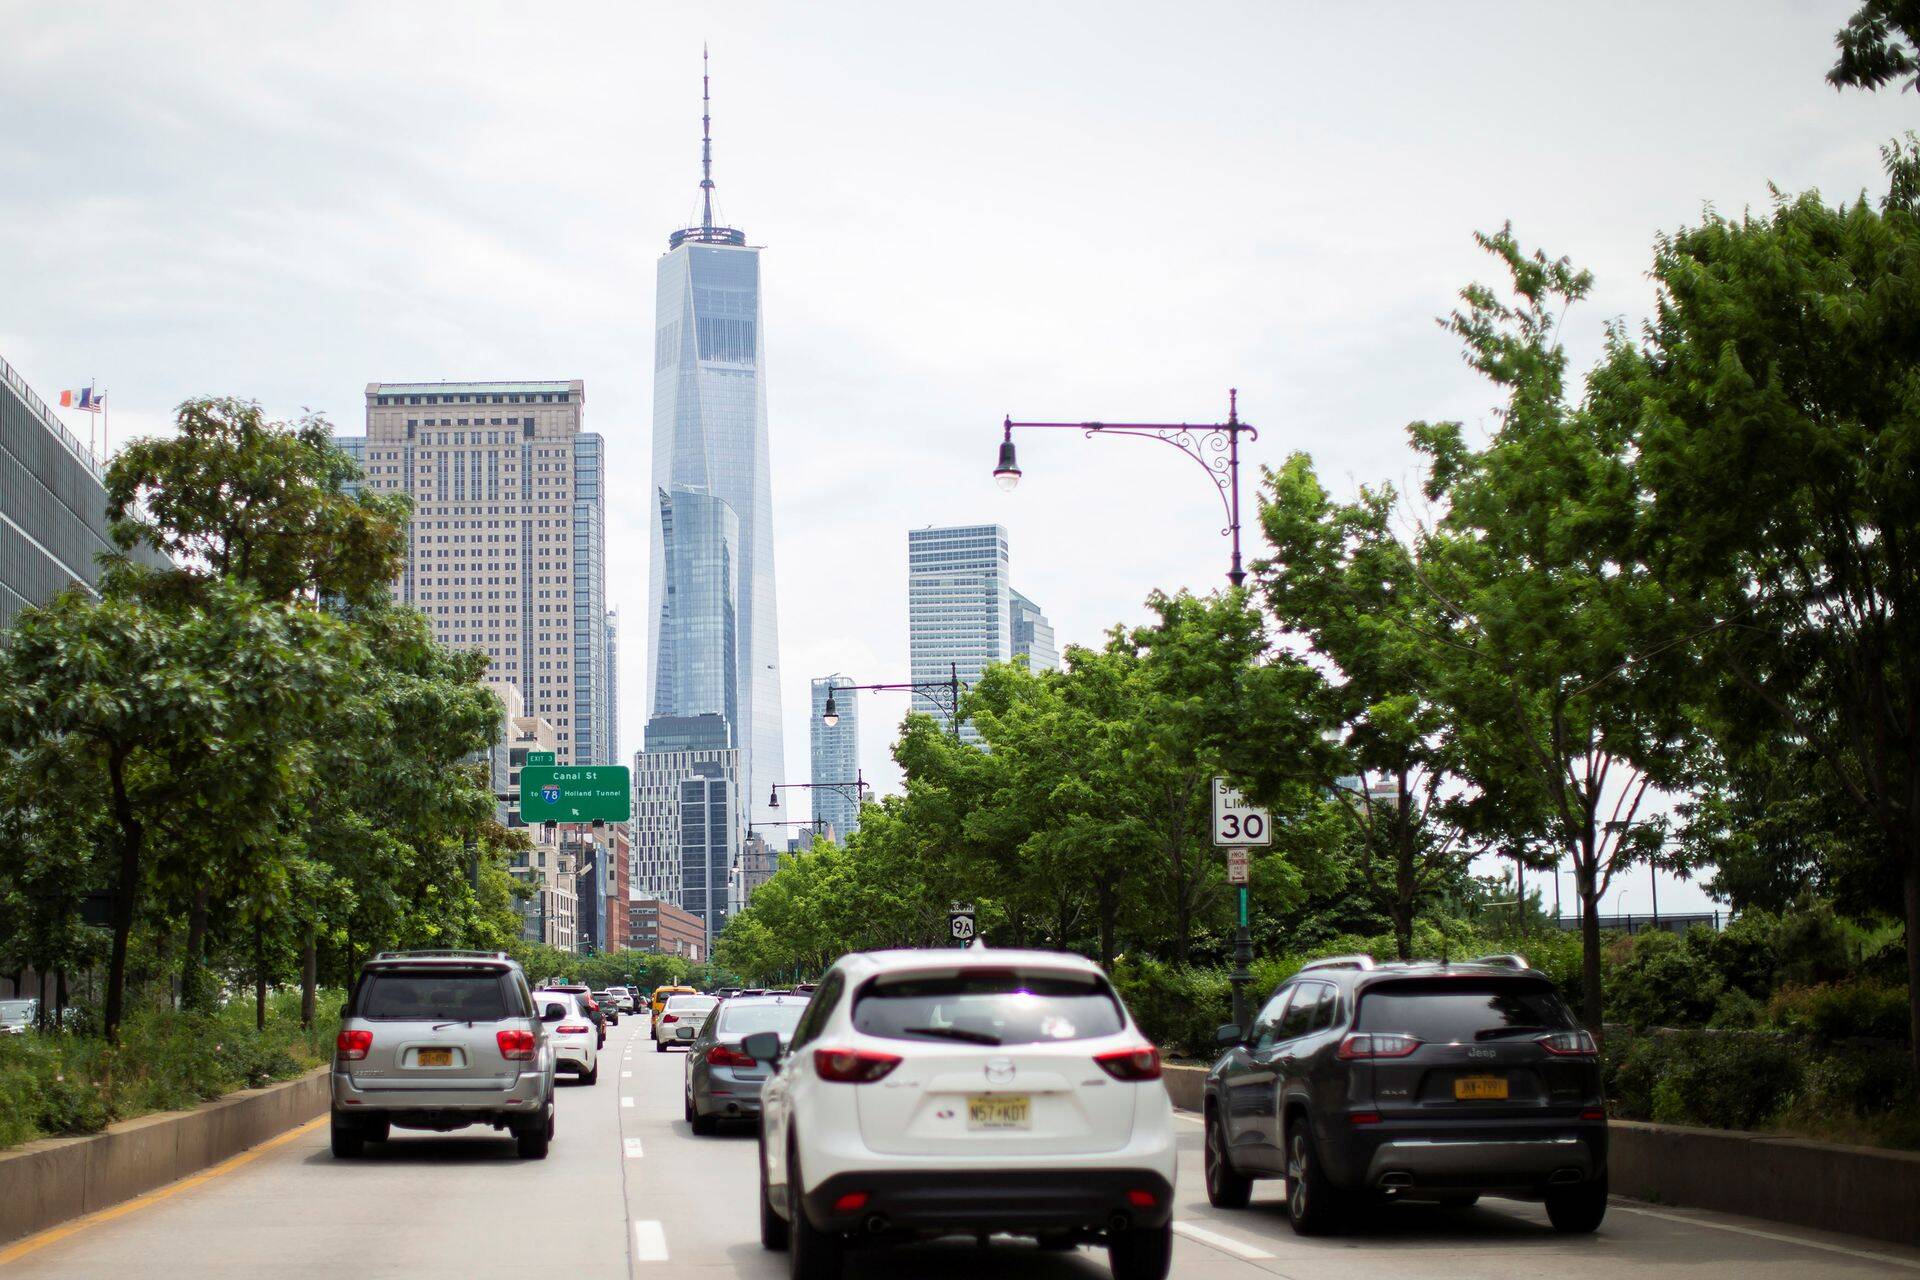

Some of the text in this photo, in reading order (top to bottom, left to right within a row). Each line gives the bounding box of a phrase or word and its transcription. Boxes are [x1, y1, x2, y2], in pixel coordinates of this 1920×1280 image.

[553, 772, 598, 780] Canal St
[543, 790, 558, 800] 78
[1221, 814, 1263, 839] 30
[954, 920, 972, 935] 9A
[1468, 1047, 1497, 1058] Jeep
